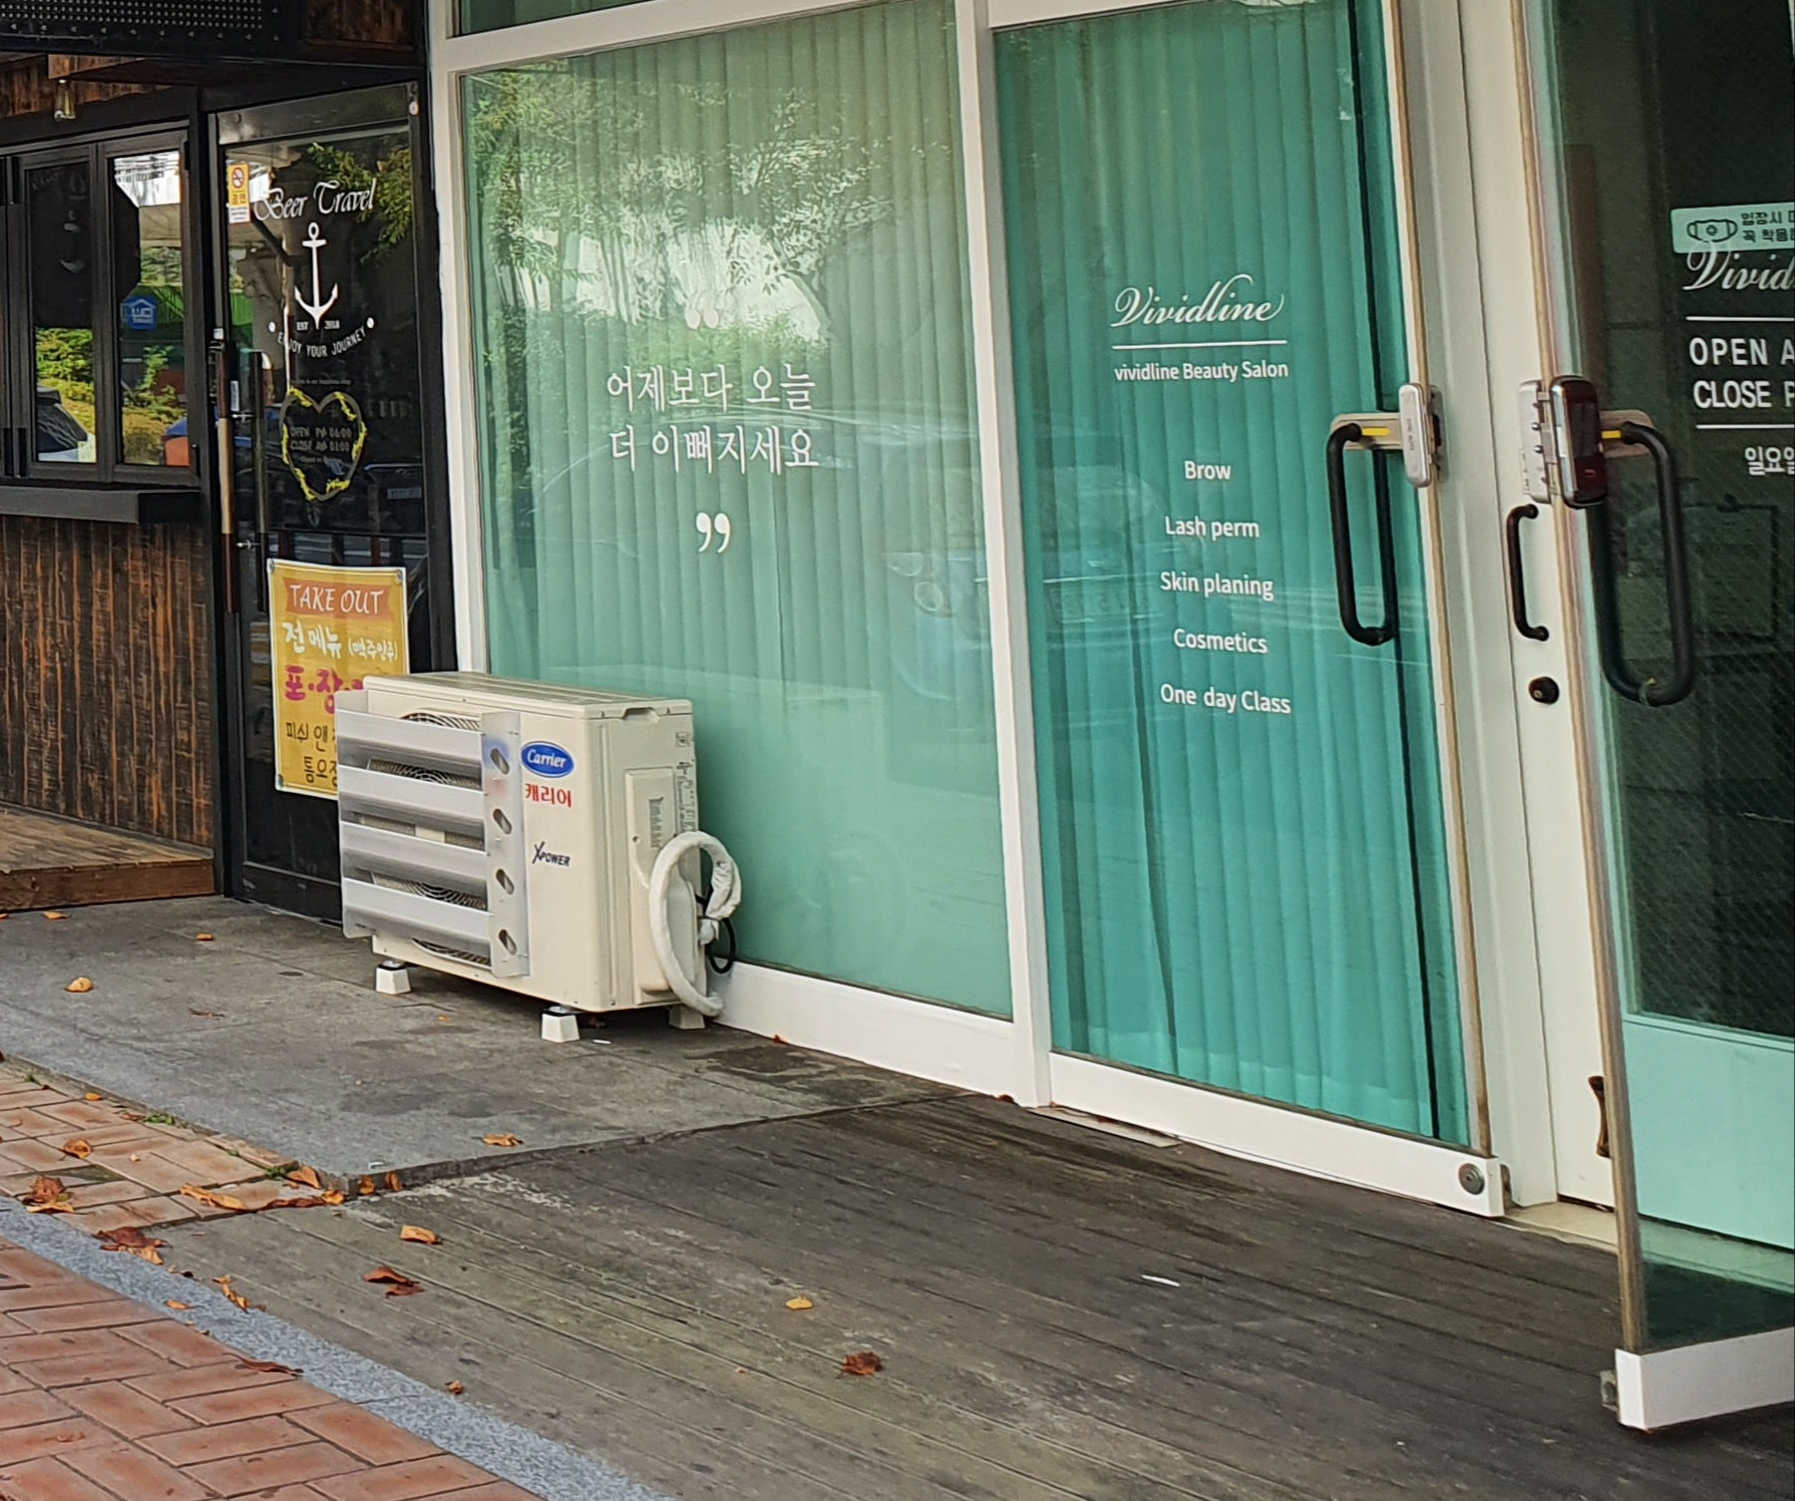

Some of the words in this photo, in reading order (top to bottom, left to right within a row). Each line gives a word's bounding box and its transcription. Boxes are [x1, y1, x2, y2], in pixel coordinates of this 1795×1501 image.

[254, 186, 308, 221] Beer
[312, 178, 374, 214] Travel
[1741, 211, 1783, 226] 입장시
[1109, 273, 1285, 329] Vividline
[277, 331, 302, 355] EJOY
[306, 344, 327, 358] YOUR
[331, 325, 366, 356] JOURNEY
[1689, 337, 1768, 366] OPEN
[1114, 362, 1179, 381] vividline
[1183, 361, 1238, 383] Beauty
[1241, 360, 1289, 379] Salon
[606, 363, 733, 413] 어제보다
[746, 363, 816, 411] 오늘
[1693, 380, 1772, 409] CLOSE
[609, 424, 636, 472] 더
[651, 424, 820, 476] 이뻐지세요
[1184, 459, 1232, 481] Brow
[1165, 516, 1206, 537] Lash
[1210, 520, 1260, 541] perm
[290, 583, 337, 613] TAKE
[340, 589, 384, 615] OUT
[1160, 571, 1200, 593] Skin
[1203, 573, 1275, 601] planing
[282, 621, 305, 655] 전
[308, 624, 342, 659] 메뉴
[1173, 628, 1269, 654] Cosmetics
[1160, 683, 1197, 706] One
[1203, 686, 1237, 714] day
[1240, 689, 1292, 715] Class
[527, 748, 568, 769] Carrier
[525, 783, 572, 808] 캐리어
